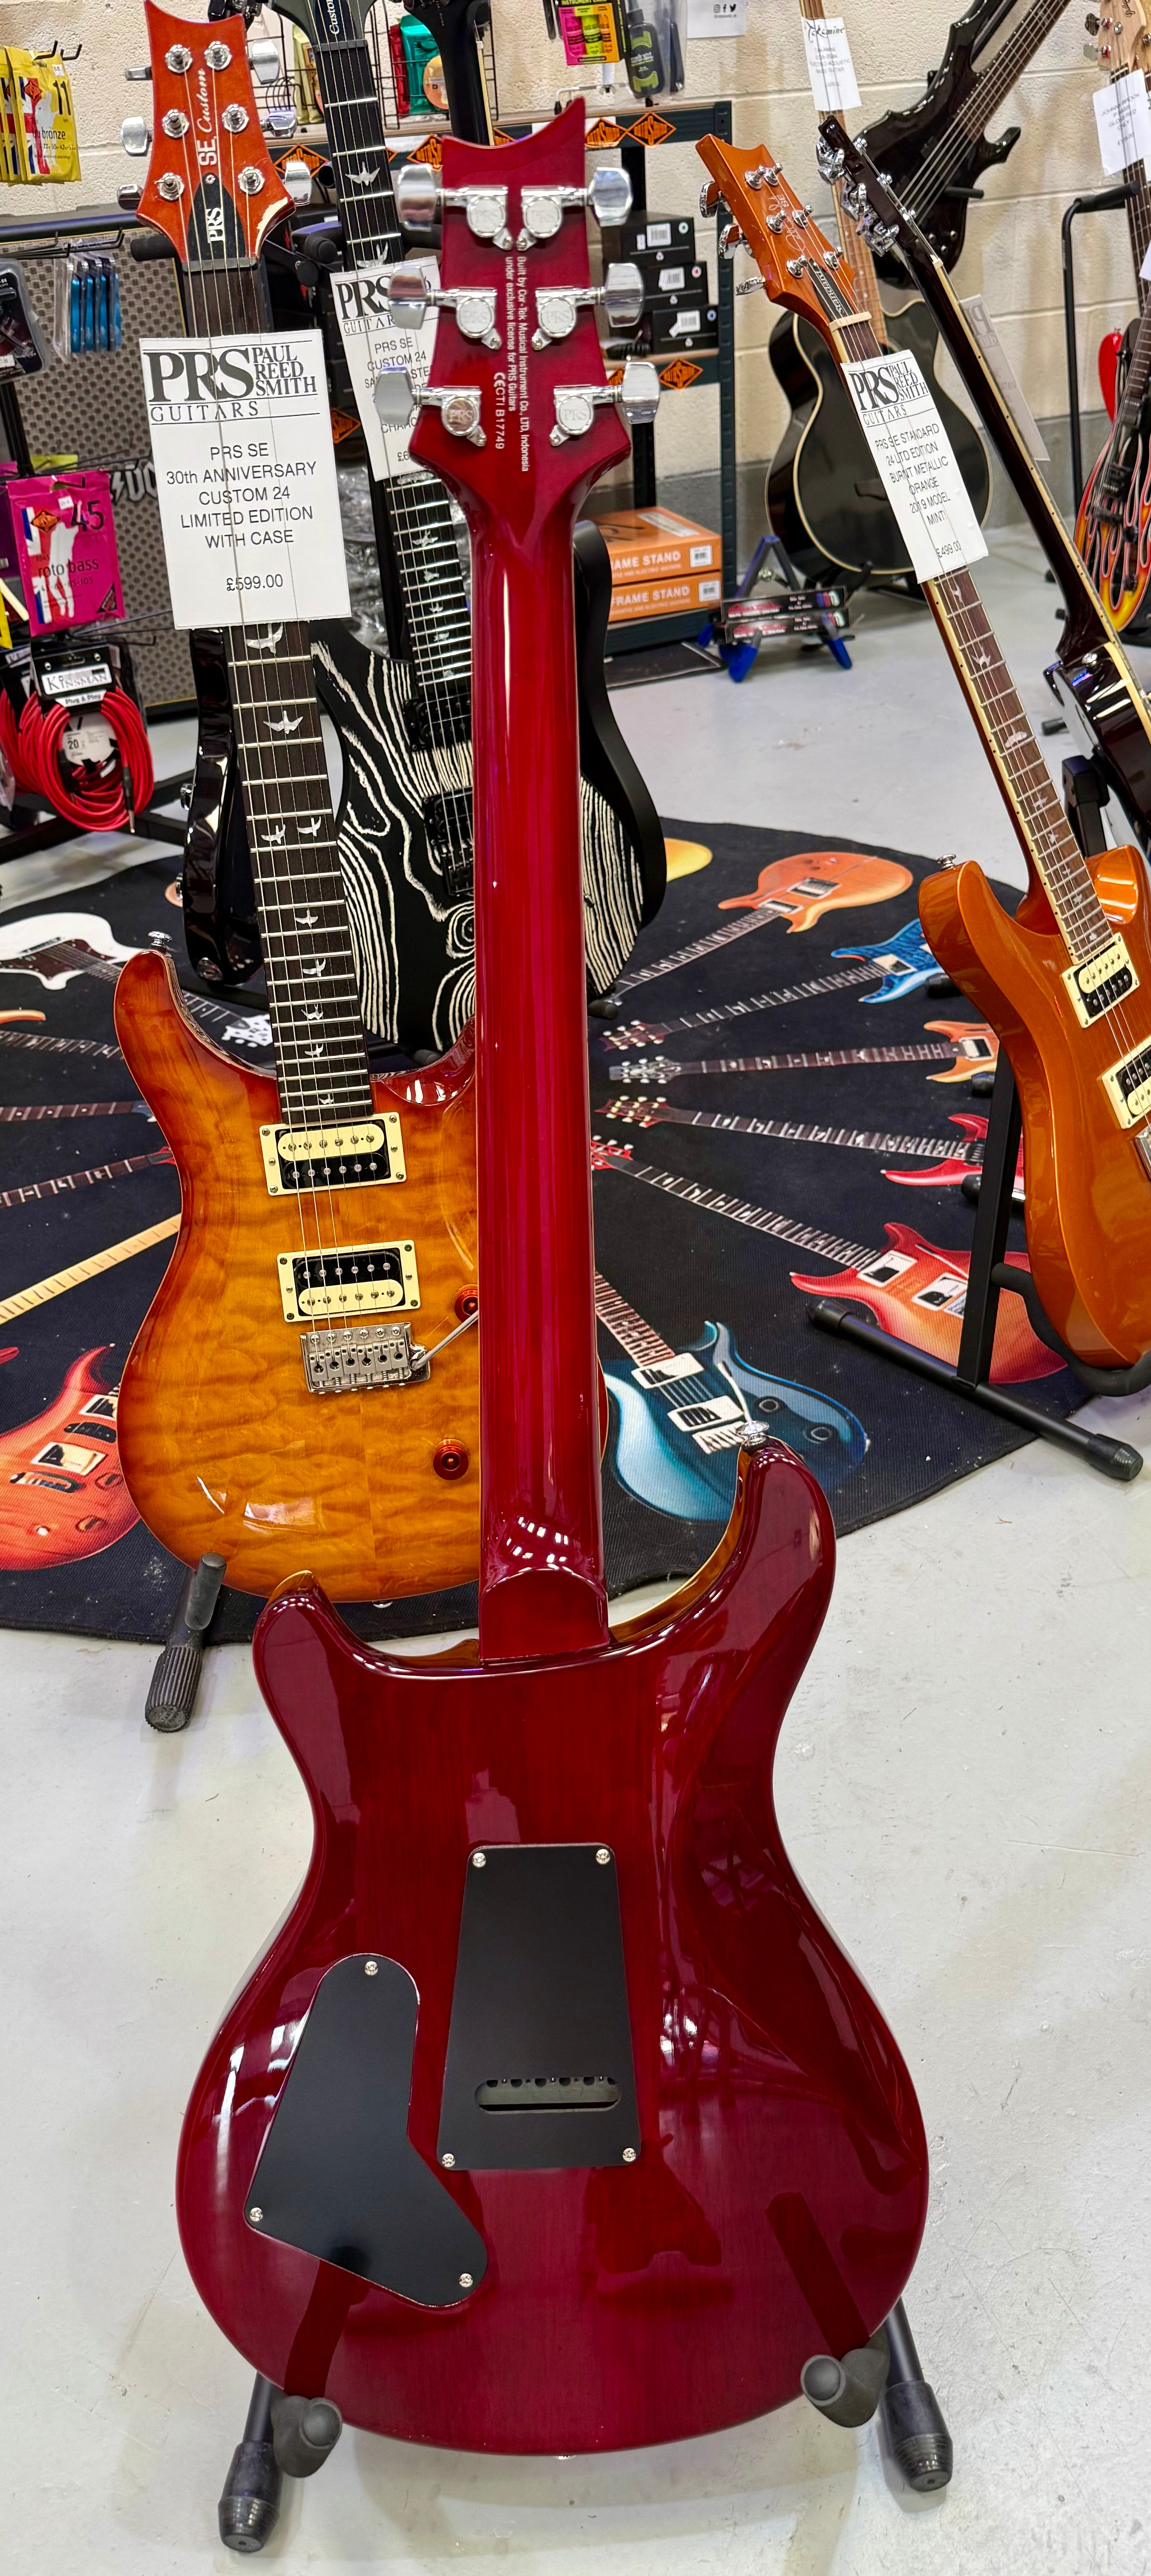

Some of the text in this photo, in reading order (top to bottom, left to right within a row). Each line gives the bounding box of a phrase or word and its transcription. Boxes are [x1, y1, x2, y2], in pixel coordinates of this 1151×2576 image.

[326, 0, 339, 34] Custo
[53, 80, 71, 115] 11
[196, 68, 212, 133] Custom
[41, 126, 65, 140] bronze
[197, 140, 217, 166] SE
[206, 207, 225, 244] PRS
[517, 256, 527, 275] Built
[516, 277, 527, 288] by
[815, 271, 845, 314] Standard
[344, 313, 396, 334] GUITAR
[505, 256, 517, 412] under exclusive license for PRS Guitars
[375, 337, 413, 354] PRS SE
[518, 322, 528, 354] Musical
[252, 345, 298, 363] PAUL
[367, 351, 426, 372] CUSTOM 24
[144, 348, 254, 402] PRS
[254, 361, 304, 379] REED
[519, 356, 528, 399] Instrument
[889, 361, 912, 377] PAUL
[256, 376, 317, 397] SMITH
[848, 366, 899, 411] PRS
[893, 372, 918, 388] REED
[898, 381, 929, 401] SMITH
[151, 401, 258, 423] GUITARS
[862, 404, 907, 426] GUITARS
[495, 409, 505, 449] B17749
[875, 423, 940, 451] PRS SE STANDARD
[210, 442, 269, 460] PRS SE
[520, 434, 530, 472] Indonesia
[886, 442, 939, 466] 24 LTD EDITION
[166, 469, 197, 485] 30th
[203, 461, 317, 483] ANNIVERSARY
[890, 456, 949, 483] BURNT METALLIC
[199, 486, 290, 506] CUSTOM 24
[909, 477, 939, 495] ORANGE
[909, 492, 951, 514] 2019 MODEL
[71, 500, 104, 532] 45
[181, 506, 313, 529] LIMITED EDITION
[205, 529, 293, 549] WITH CASE
[610, 550, 681, 570] AME STAND
[935, 541, 962, 559] £499.00
[38, 558, 99, 578] roto bass
[226, 573, 283, 591] £599.00
[652, 586, 691, 601] STAND
[68, 739, 79, 750] 20
